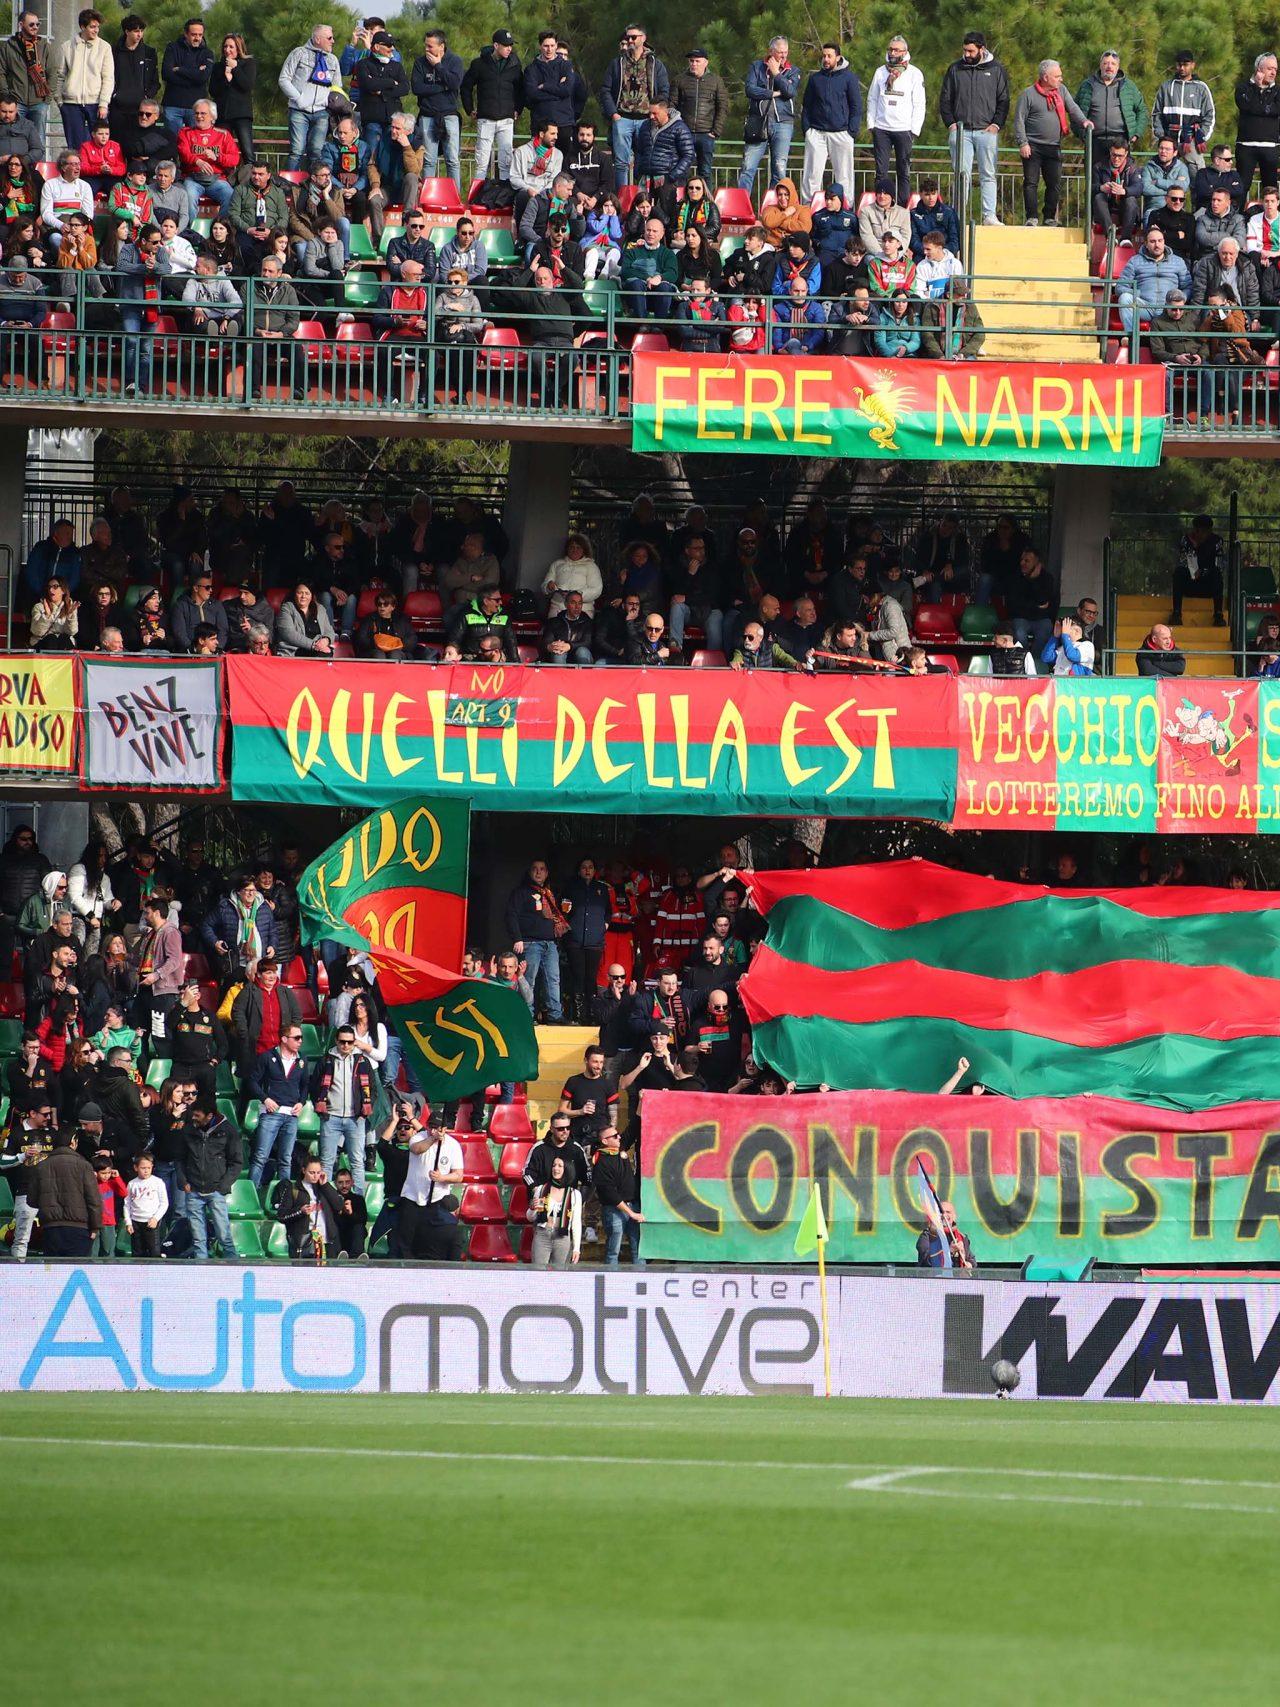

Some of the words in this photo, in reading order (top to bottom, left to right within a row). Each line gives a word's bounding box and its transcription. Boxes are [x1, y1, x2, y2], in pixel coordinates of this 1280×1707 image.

[655, 366, 833, 445] FERE
[935, 374, 1143, 454] NARNI
[98, 676, 188, 738] BENZ
[470, 667, 505, 694] NO
[286, 687, 519, 787] QUELLI
[553, 693, 748, 794] DELLA
[779, 698, 898, 795] EST
[498, 703, 511, 727] 9
[964, 692, 1160, 767] VECCHIO
[966, 779, 1144, 817] LOTTEREMO
[1154, 783, 1226, 818] FINO
[664, 1275, 816, 1300] center
[19, 1268, 821, 1396] Automotive
